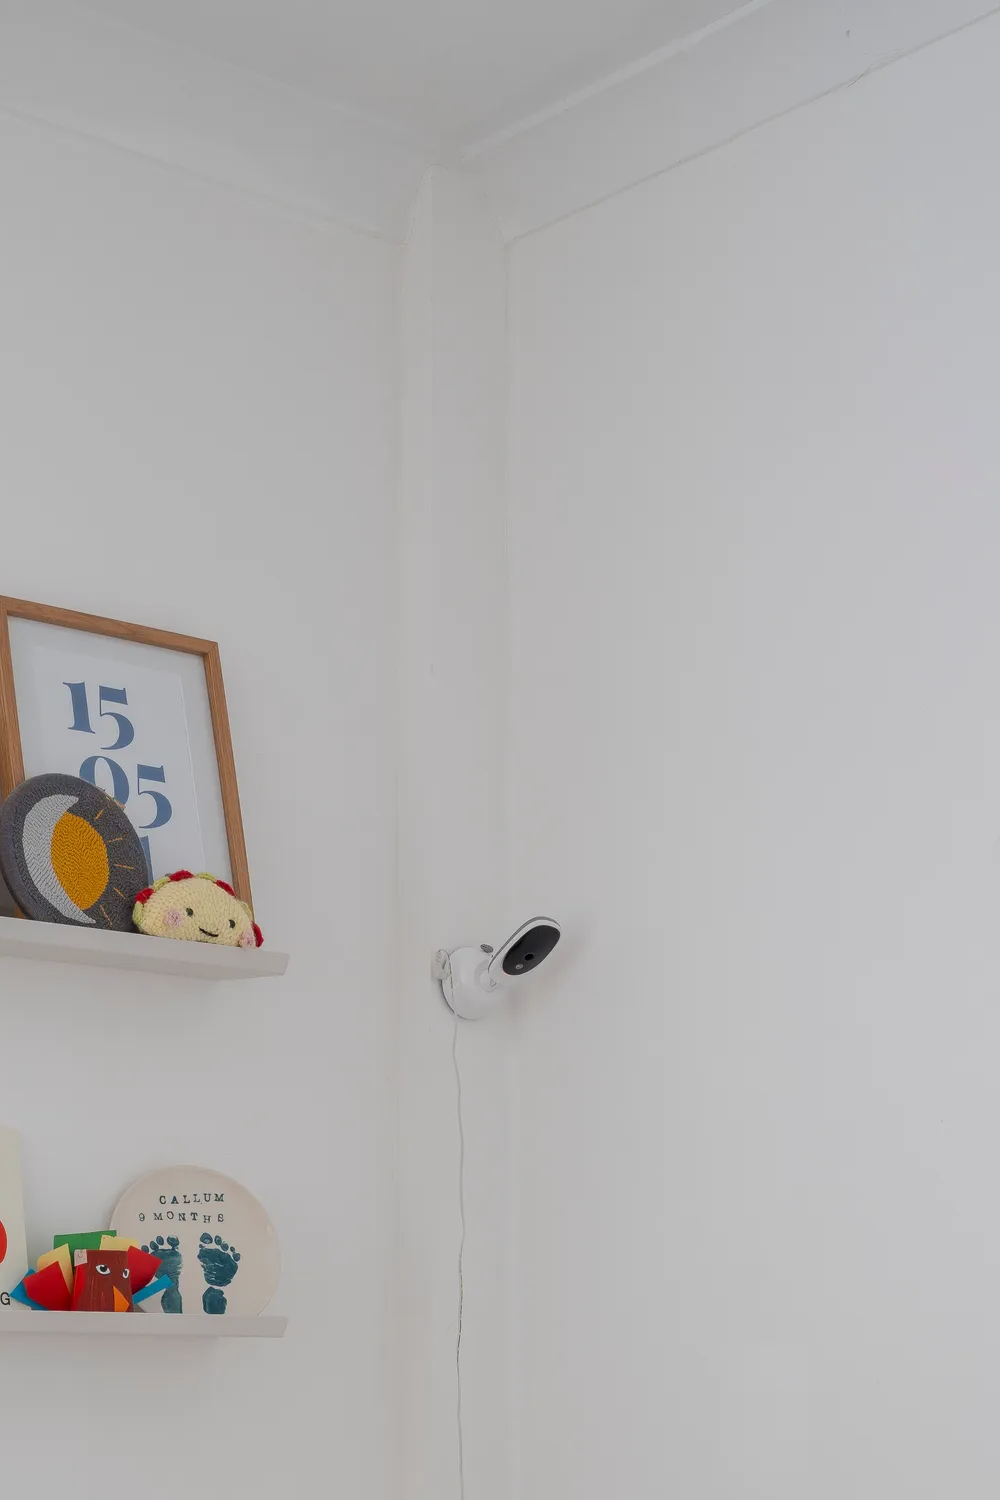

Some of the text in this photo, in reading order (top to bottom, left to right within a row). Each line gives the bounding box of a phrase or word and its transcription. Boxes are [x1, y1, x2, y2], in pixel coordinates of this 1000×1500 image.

[62, 681, 135, 751] 15
[159, 1193, 225, 1205] CALLUM
[138, 1211, 224, 1223] 9 MONTHS
